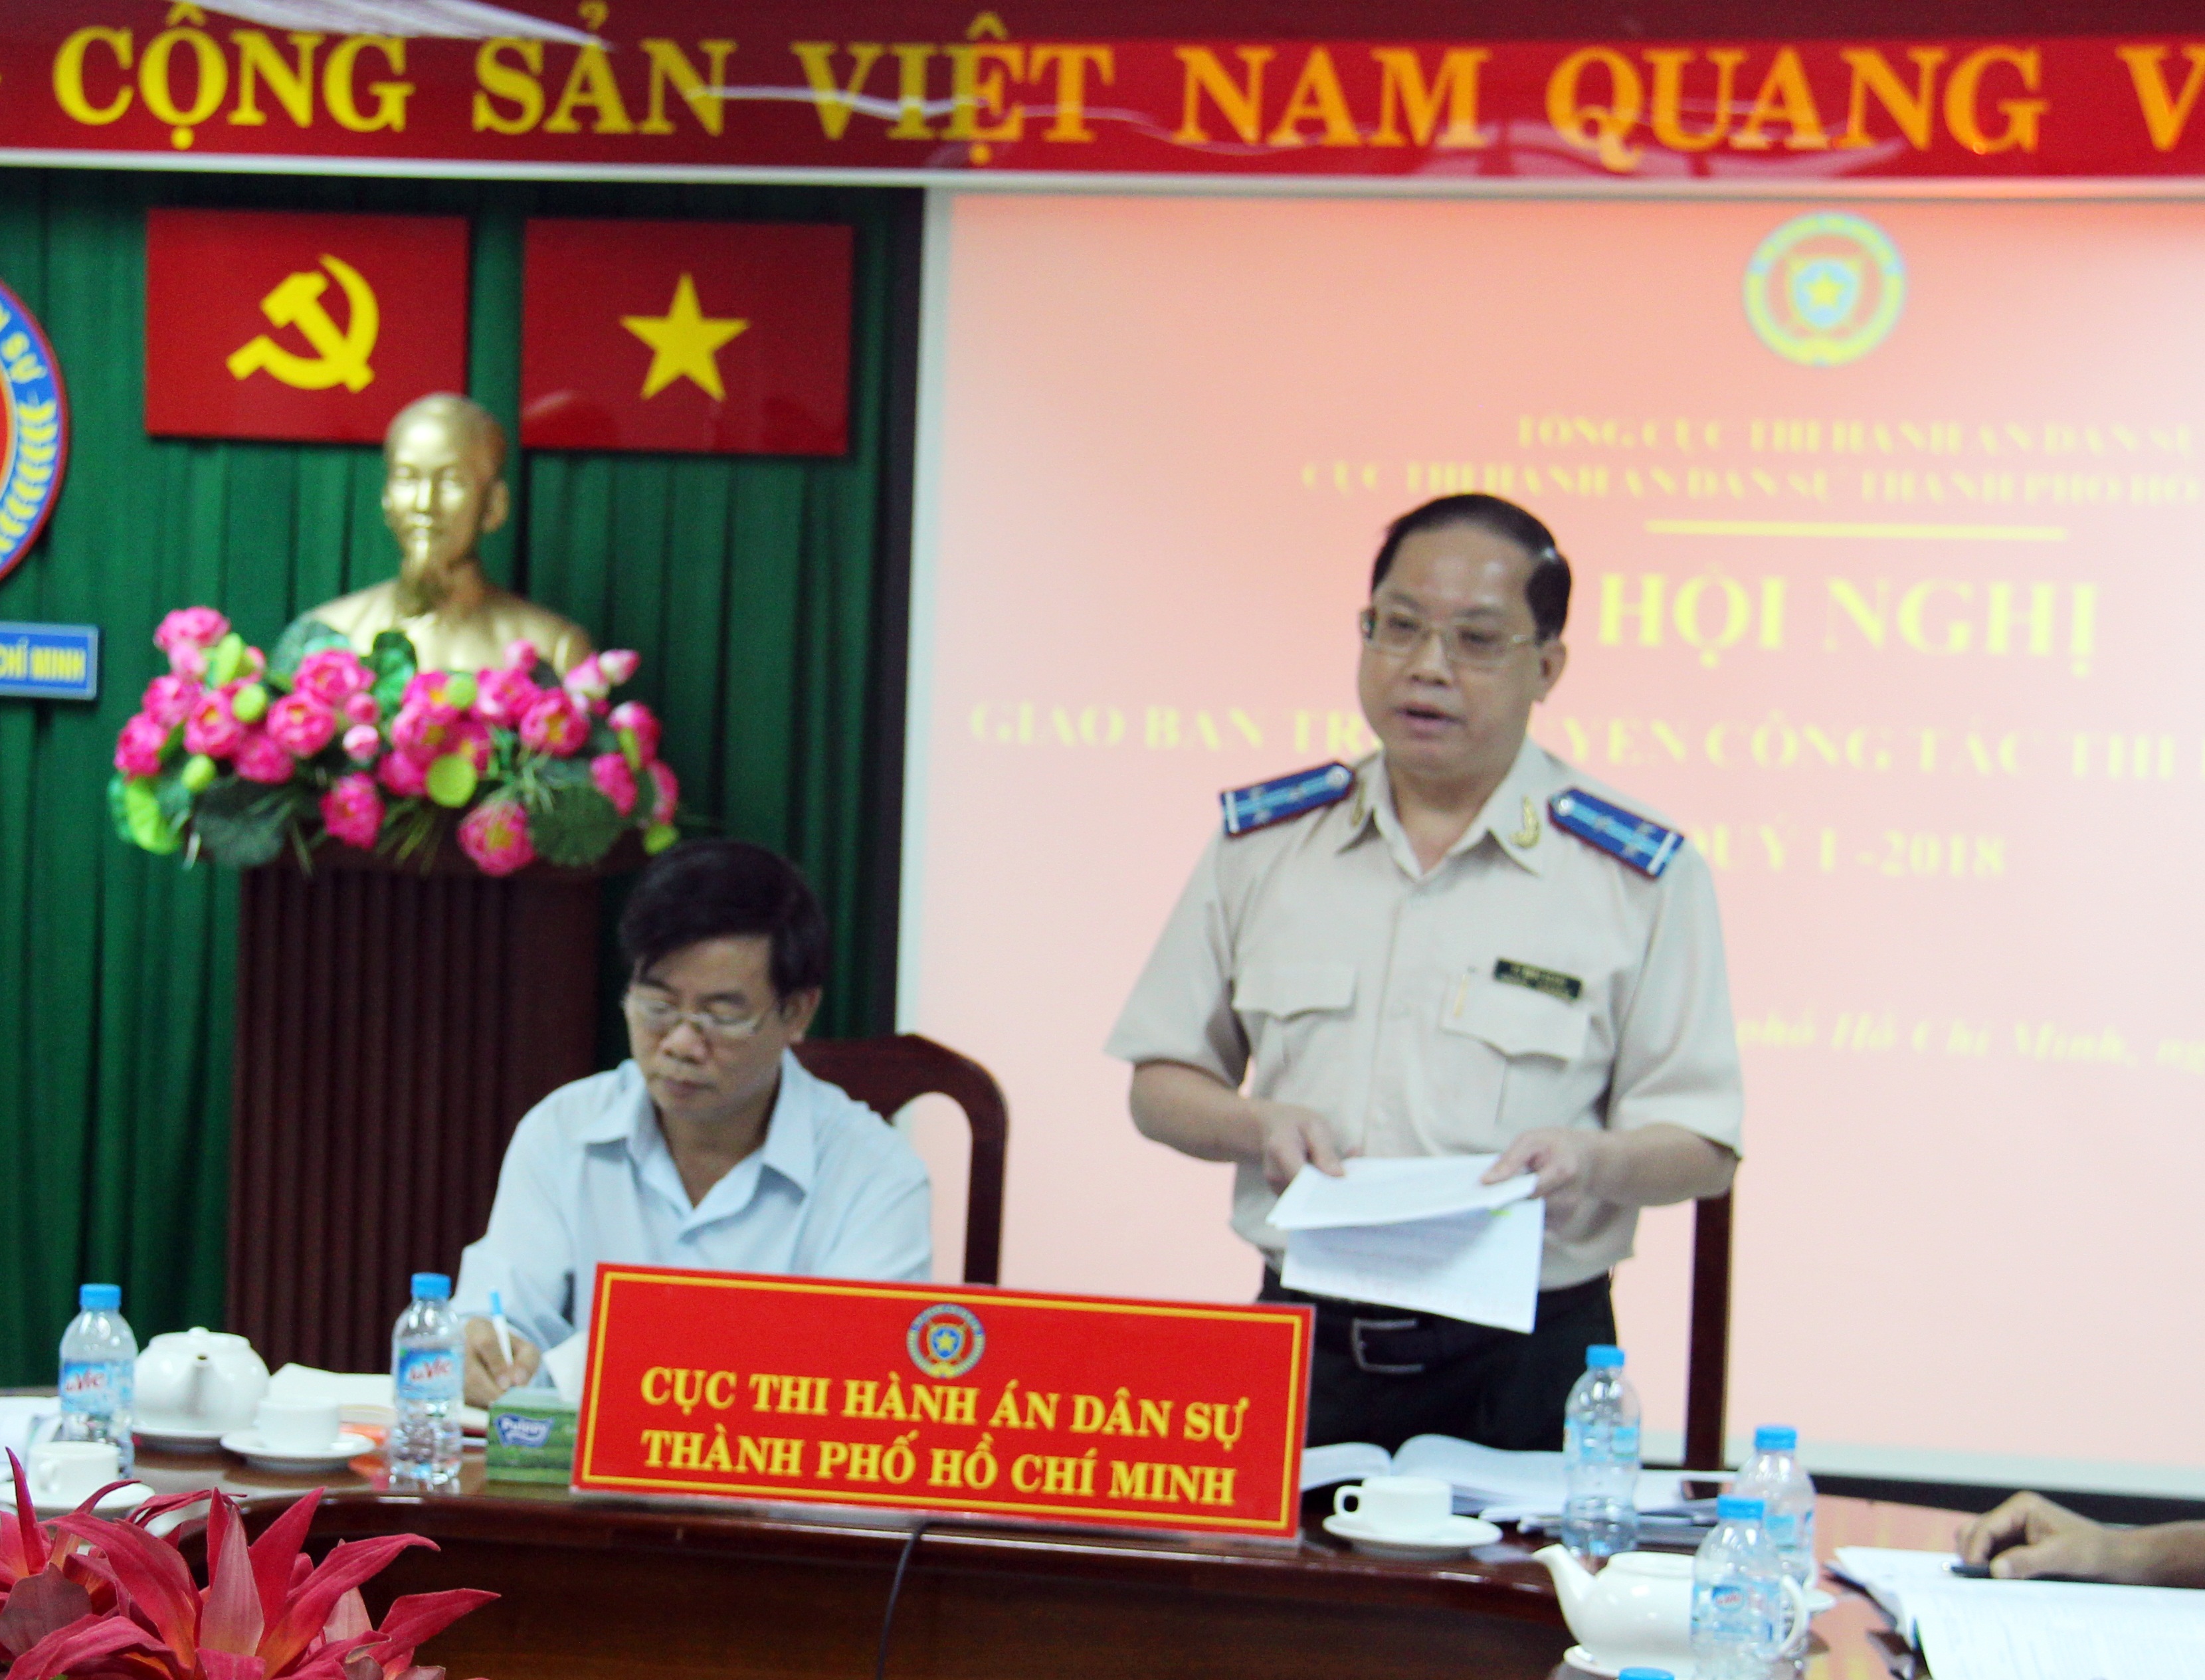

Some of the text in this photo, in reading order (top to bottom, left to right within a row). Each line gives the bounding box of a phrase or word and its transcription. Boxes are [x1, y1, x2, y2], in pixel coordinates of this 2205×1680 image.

[52, 0, 415, 151] CỘNG
[470, 1, 736, 136] SẢN
[789, 11, 1116, 166] VIỆT
[1173, 45, 1491, 149] NAM
[1544, 45, 2049, 173] QUANG
[1823, 578, 2099, 679] NGHỊ
[1285, 708, 1383, 757] TR
[640, 1366, 1250, 1452] CỤC THI HÀNH ÁN DÂN SỰ
[640, 1422, 1237, 1507] THÀNH PHỐ HỒ CHÍ MINH
